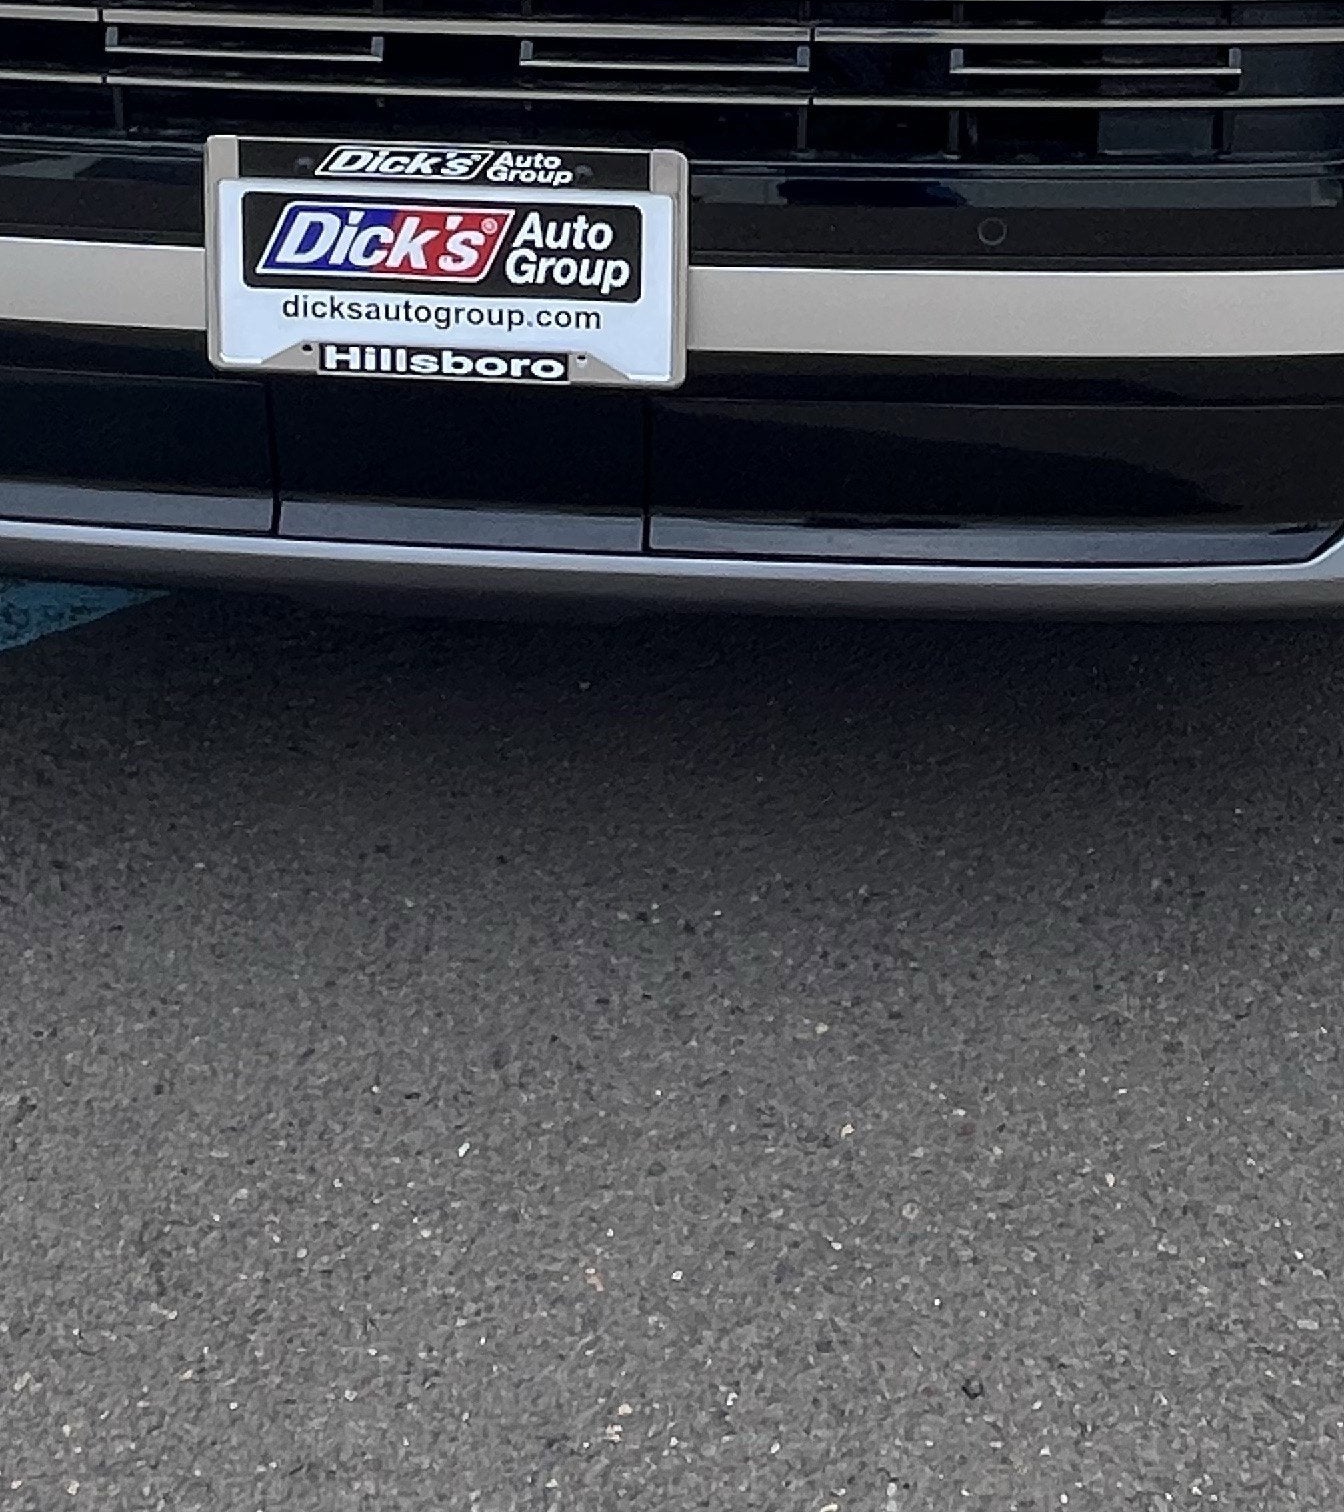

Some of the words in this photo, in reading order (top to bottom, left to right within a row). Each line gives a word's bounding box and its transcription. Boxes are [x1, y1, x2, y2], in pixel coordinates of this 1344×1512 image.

[328, 150, 474, 176] Dick's
[486, 166, 574, 186] Group
[493, 151, 562, 169] Auto
[275, 211, 486, 275] Dick's
[512, 212, 613, 252] Auto
[505, 248, 630, 294] Group
[282, 295, 602, 331] dicksautogroup.com
[324, 345, 565, 380] Hillsboro
